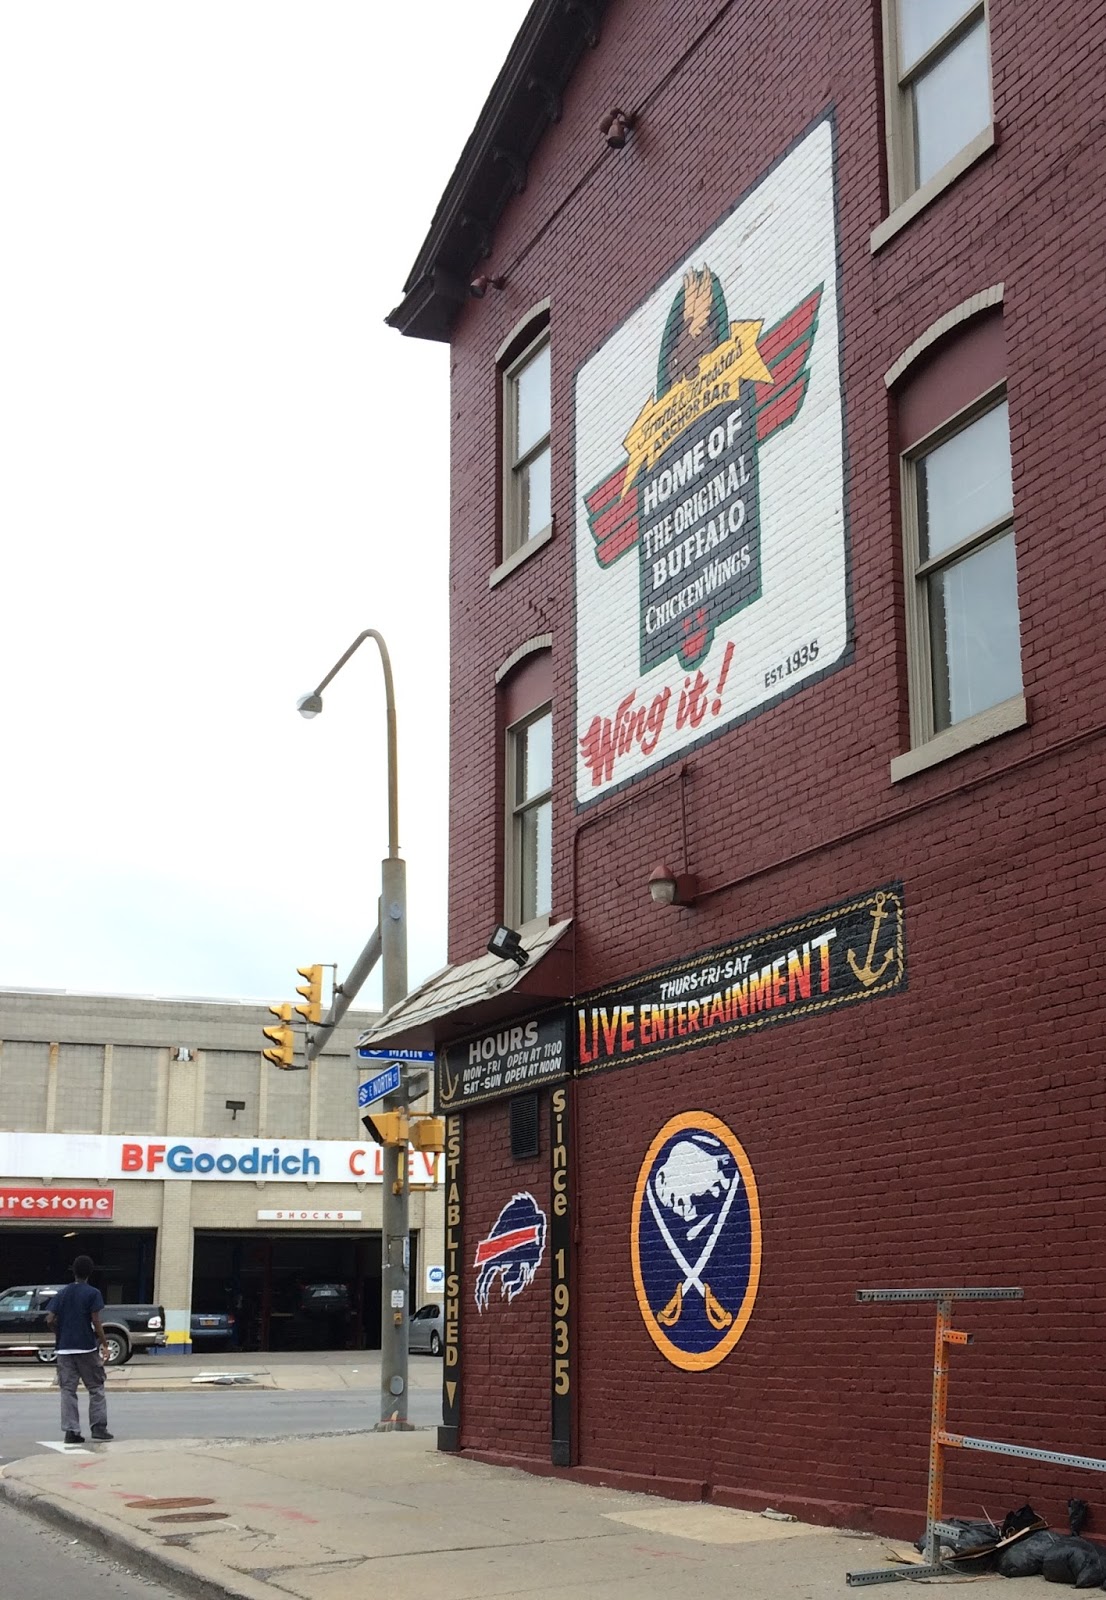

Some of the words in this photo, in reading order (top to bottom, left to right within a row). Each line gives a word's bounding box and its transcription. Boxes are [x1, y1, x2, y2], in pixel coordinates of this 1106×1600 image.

[653, 398, 700, 459] ANCHOR
[703, 382, 731, 409] BAR
[643, 438, 705, 516] HOME
[707, 407, 743, 460] OF
[643, 516, 673, 560] THE
[674, 454, 751, 535] ORIGINAL
[652, 499, 746, 590] BUFFALO
[645, 575, 704, 635] CHICKEN
[764, 664, 784, 689] EST.
[785, 639, 819, 676] 1935
[578, 687, 672, 787] Wing
[675, 640, 736, 730] it!
[577, 1005, 636, 1065] LIVE
[639, 929, 838, 1045] ENTERTAINMENT
[388, 1049, 424, 1059] MAIN
[462, 1059, 502, 1082] MON-FRI
[506, 1051, 529, 1069] OPEN
[530, 1046, 542, 1061] AT
[463, 1073, 502, 1095] SAT-SUN
[504, 1066, 527, 1084] OPEN
[527, 1063, 539, 1077] AT
[539, 1057, 562, 1075] NOON
[468, 1021, 539, 1065] HOURS
[373, 1071, 393, 1097] NORTH
[121, 1143, 321, 1175] BFGoodrich
[552, 1089, 568, 1216] Since
[276, 1211, 344, 1220] SHOCKS
[446, 1115, 461, 1367] ESTABLISHED
[554, 1249, 571, 1396] 1935
